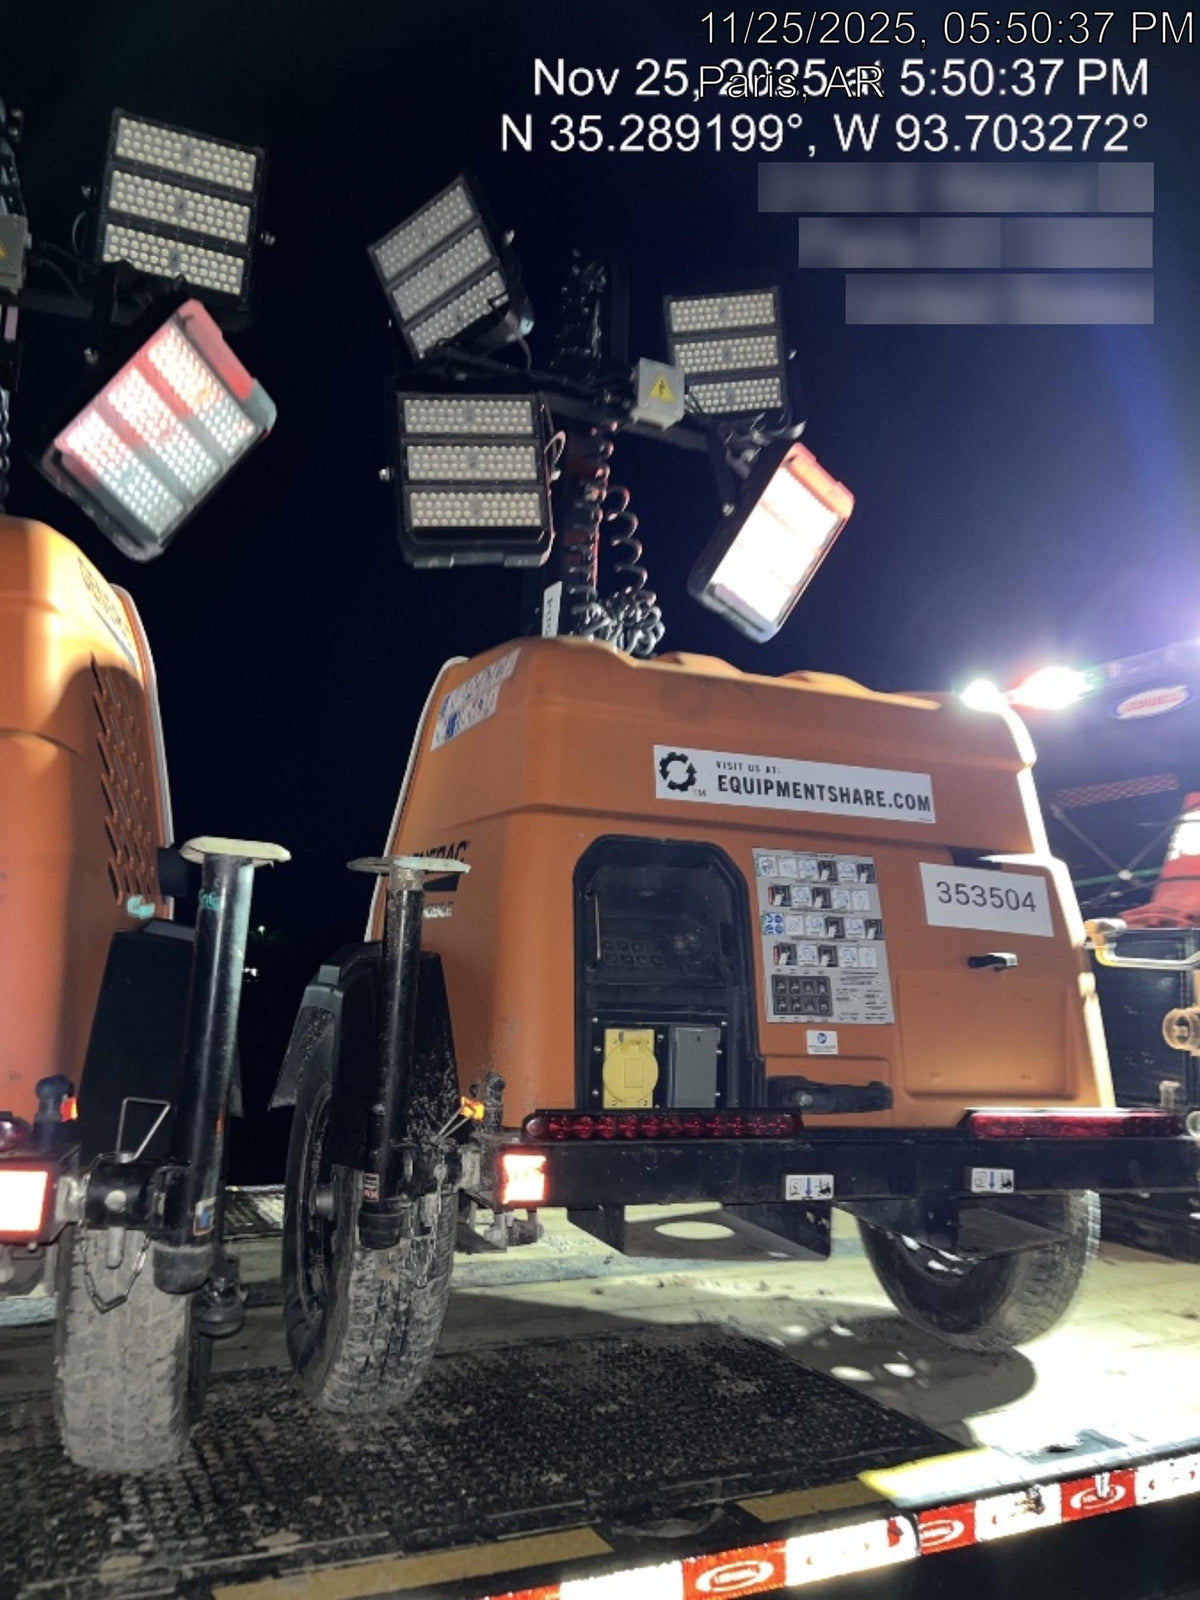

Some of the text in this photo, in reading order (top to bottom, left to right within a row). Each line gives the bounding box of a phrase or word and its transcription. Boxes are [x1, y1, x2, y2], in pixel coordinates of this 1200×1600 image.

[715, 760, 743, 772] VISIT
[748, 764, 761, 773] US
[717, 774, 931, 813] EQUIPMENTSHARE.COM
[936, 881, 1037, 913] 353504
